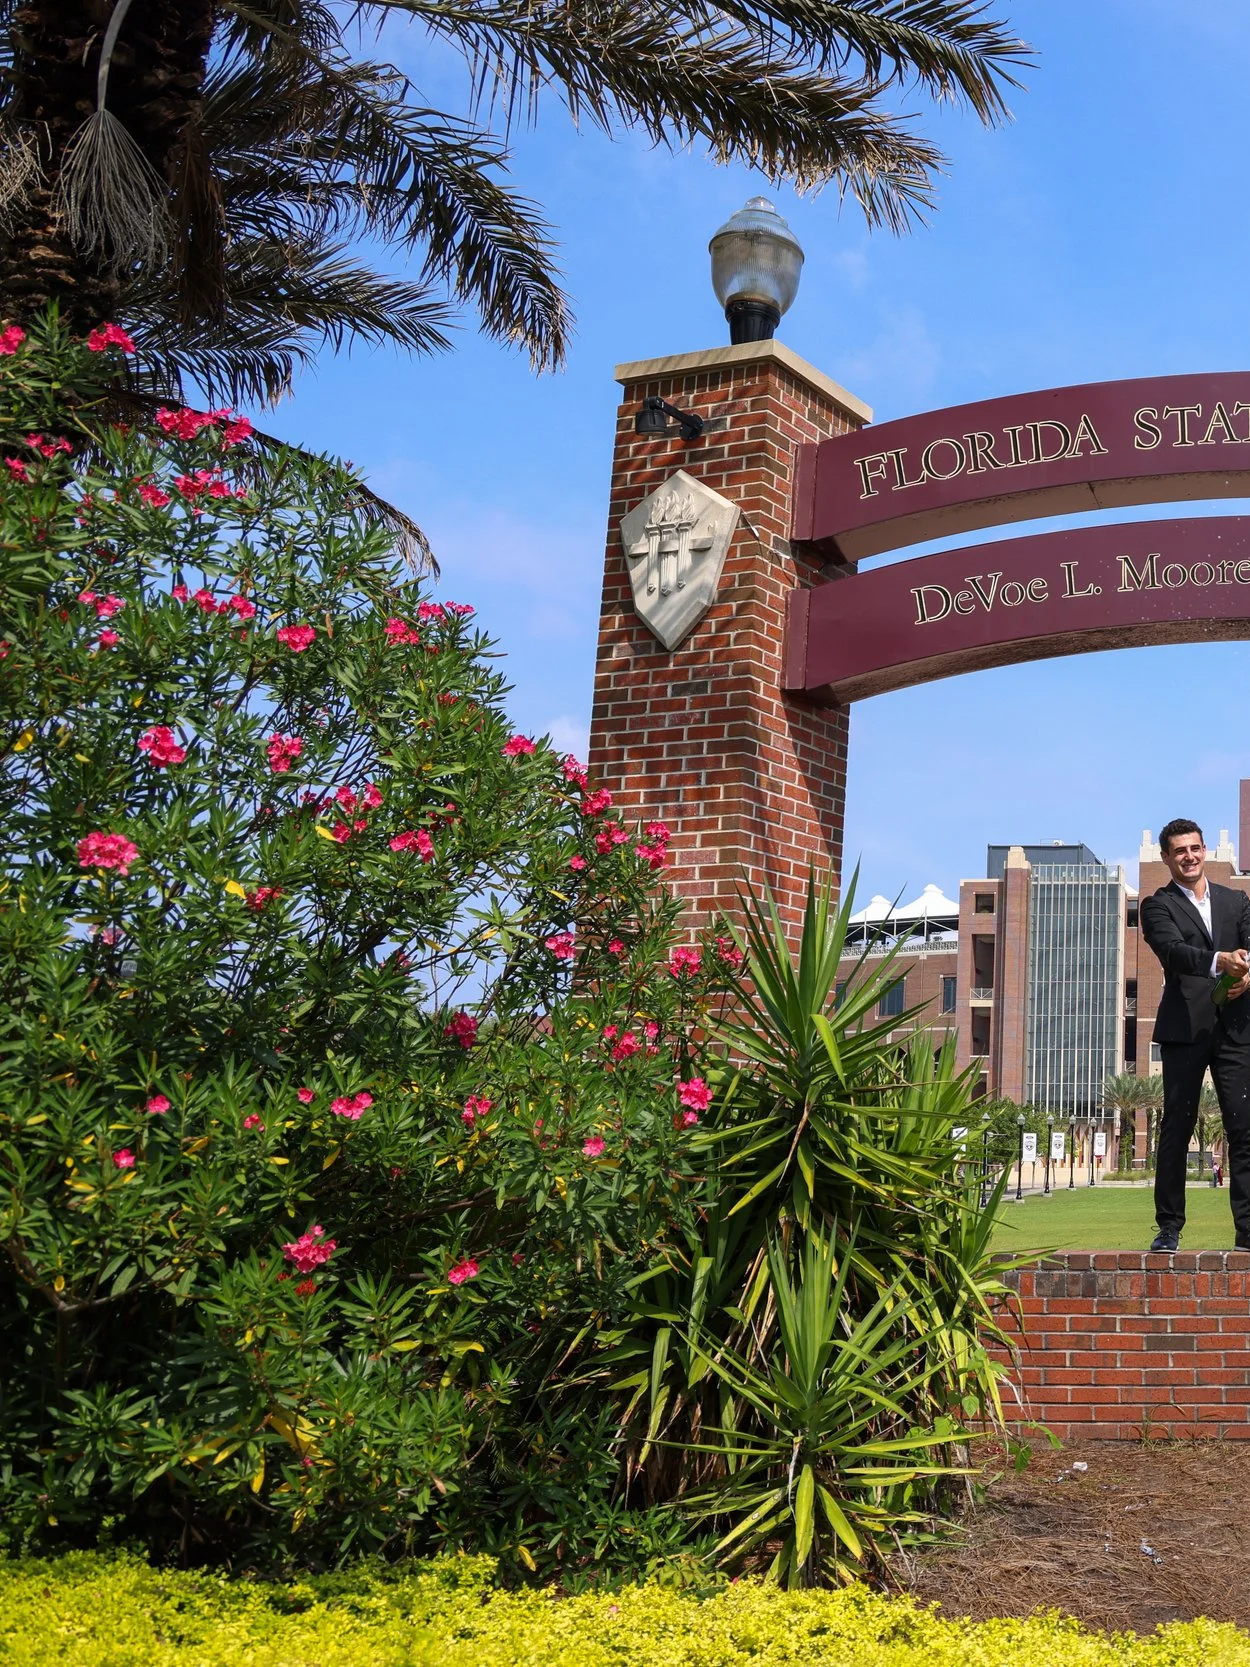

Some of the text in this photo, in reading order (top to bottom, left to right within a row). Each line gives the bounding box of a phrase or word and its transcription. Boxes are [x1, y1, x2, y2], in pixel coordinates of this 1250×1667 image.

[854, 414, 1108, 499] FLORIDA
[910, 571, 1048, 625] DeVoe
[1060, 561, 1102, 599] L.
